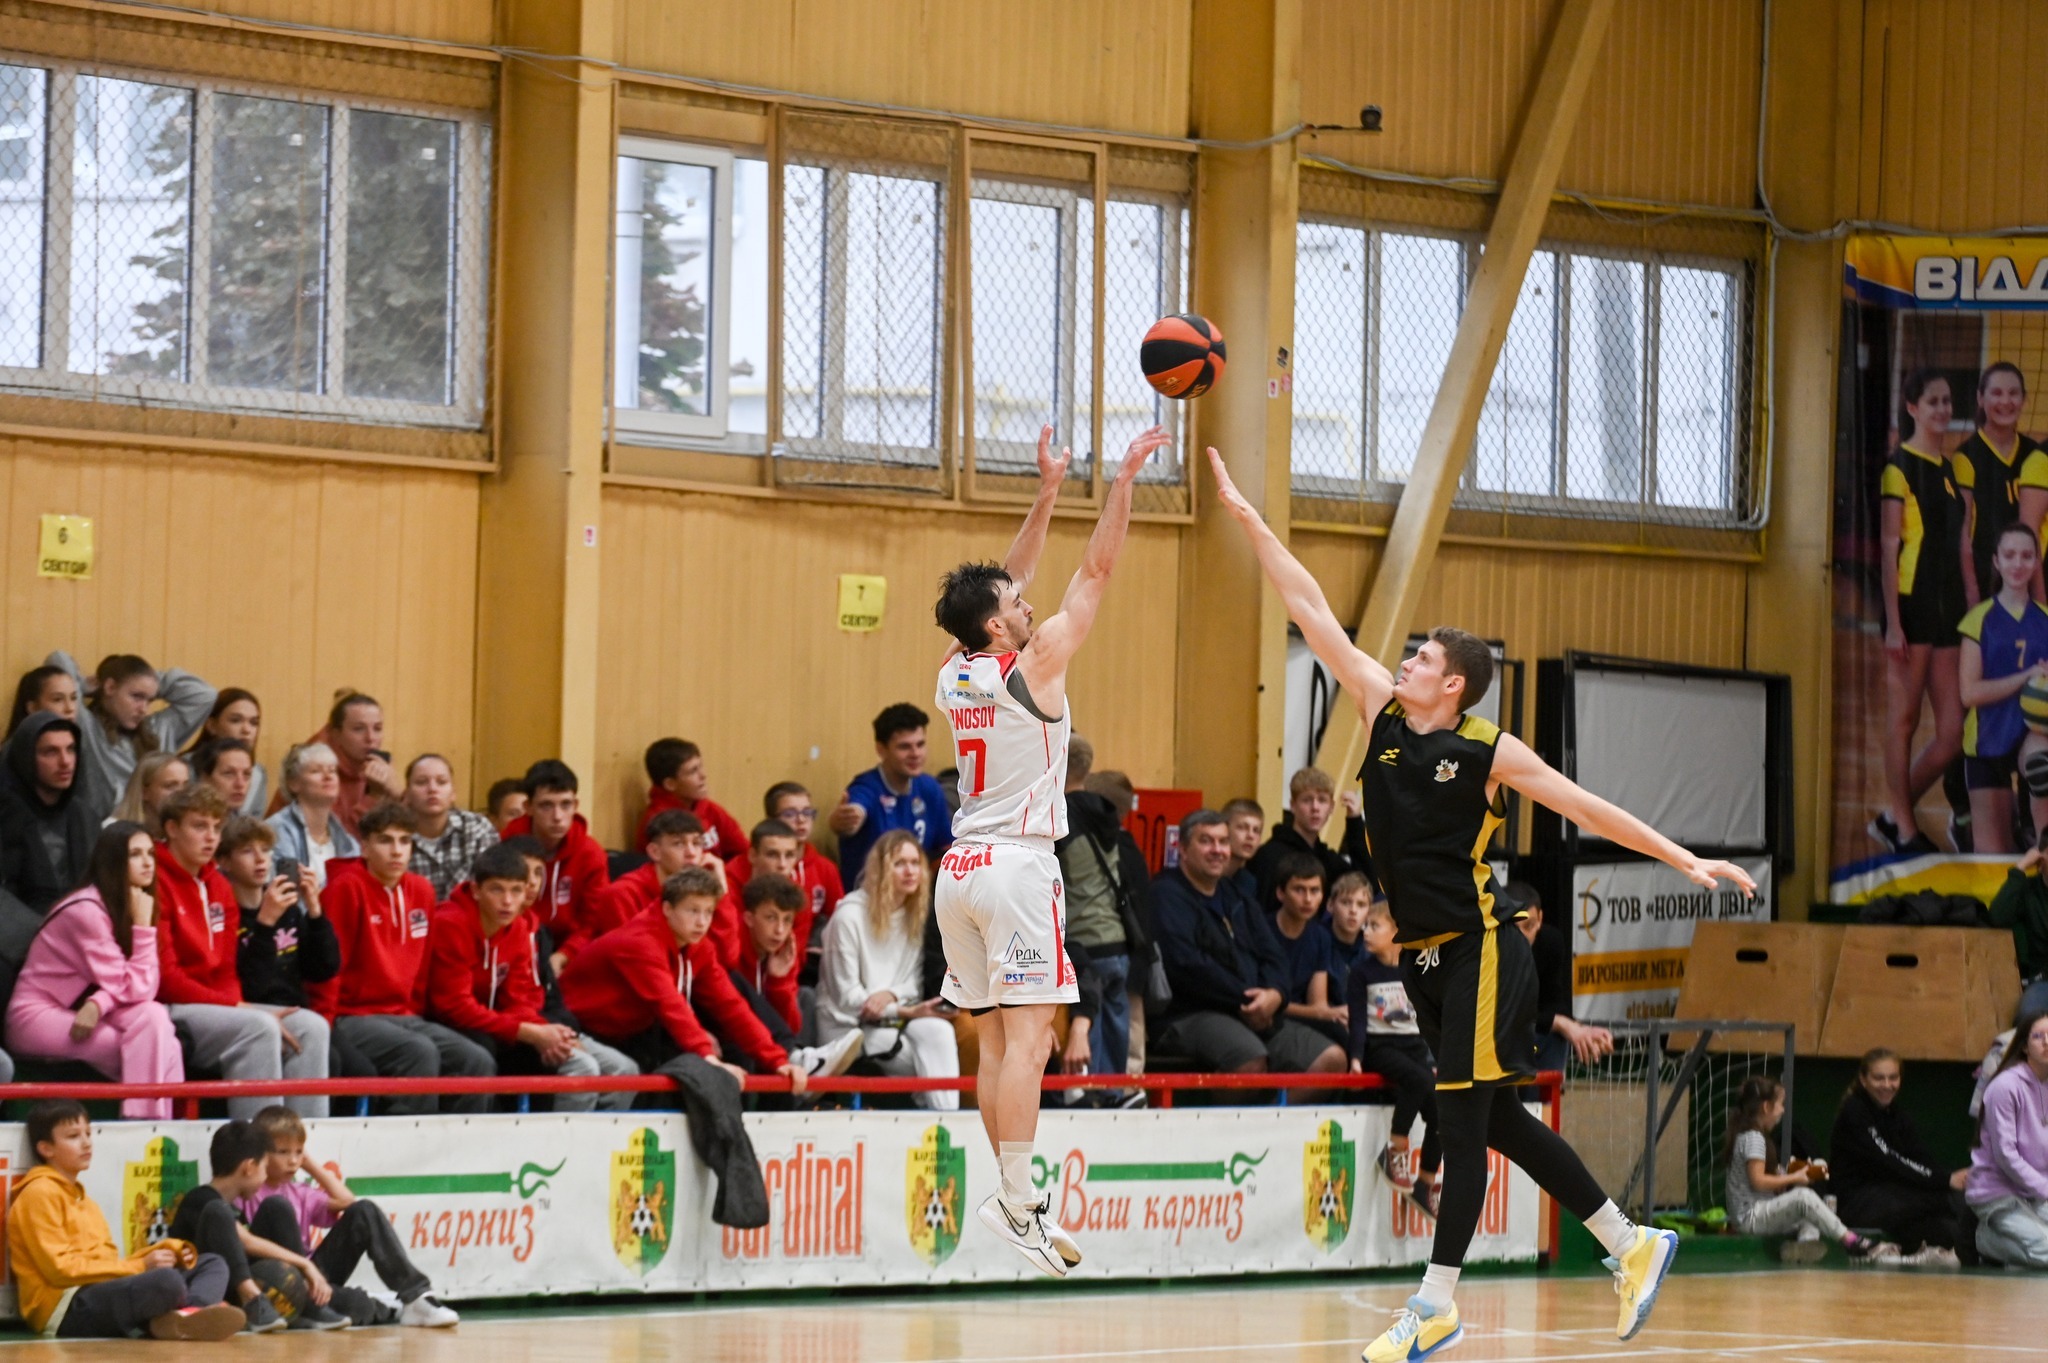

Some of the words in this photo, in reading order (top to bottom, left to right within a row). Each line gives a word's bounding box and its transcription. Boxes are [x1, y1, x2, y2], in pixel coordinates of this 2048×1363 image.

[58, 526, 68, 545] 6
[42, 559, 88, 575] СЕКТОР
[2015, 639, 2027, 669] 7
[958, 738, 987, 797] 7
[1607, 897, 1641, 924] ТОВ
[1646, 886, 1713, 922] «НОВИЙ
[1719, 891, 1766, 922] ДВІР»
[1015, 948, 1042, 960] РДК
[1005, 973, 1025, 983] PST
[1577, 963, 1648, 985] ВИРОБНИК
[1058, 1148, 1131, 1232] Ваш
[1143, 1190, 1244, 1246] карниз
[410, 1204, 535, 1267] карниз
